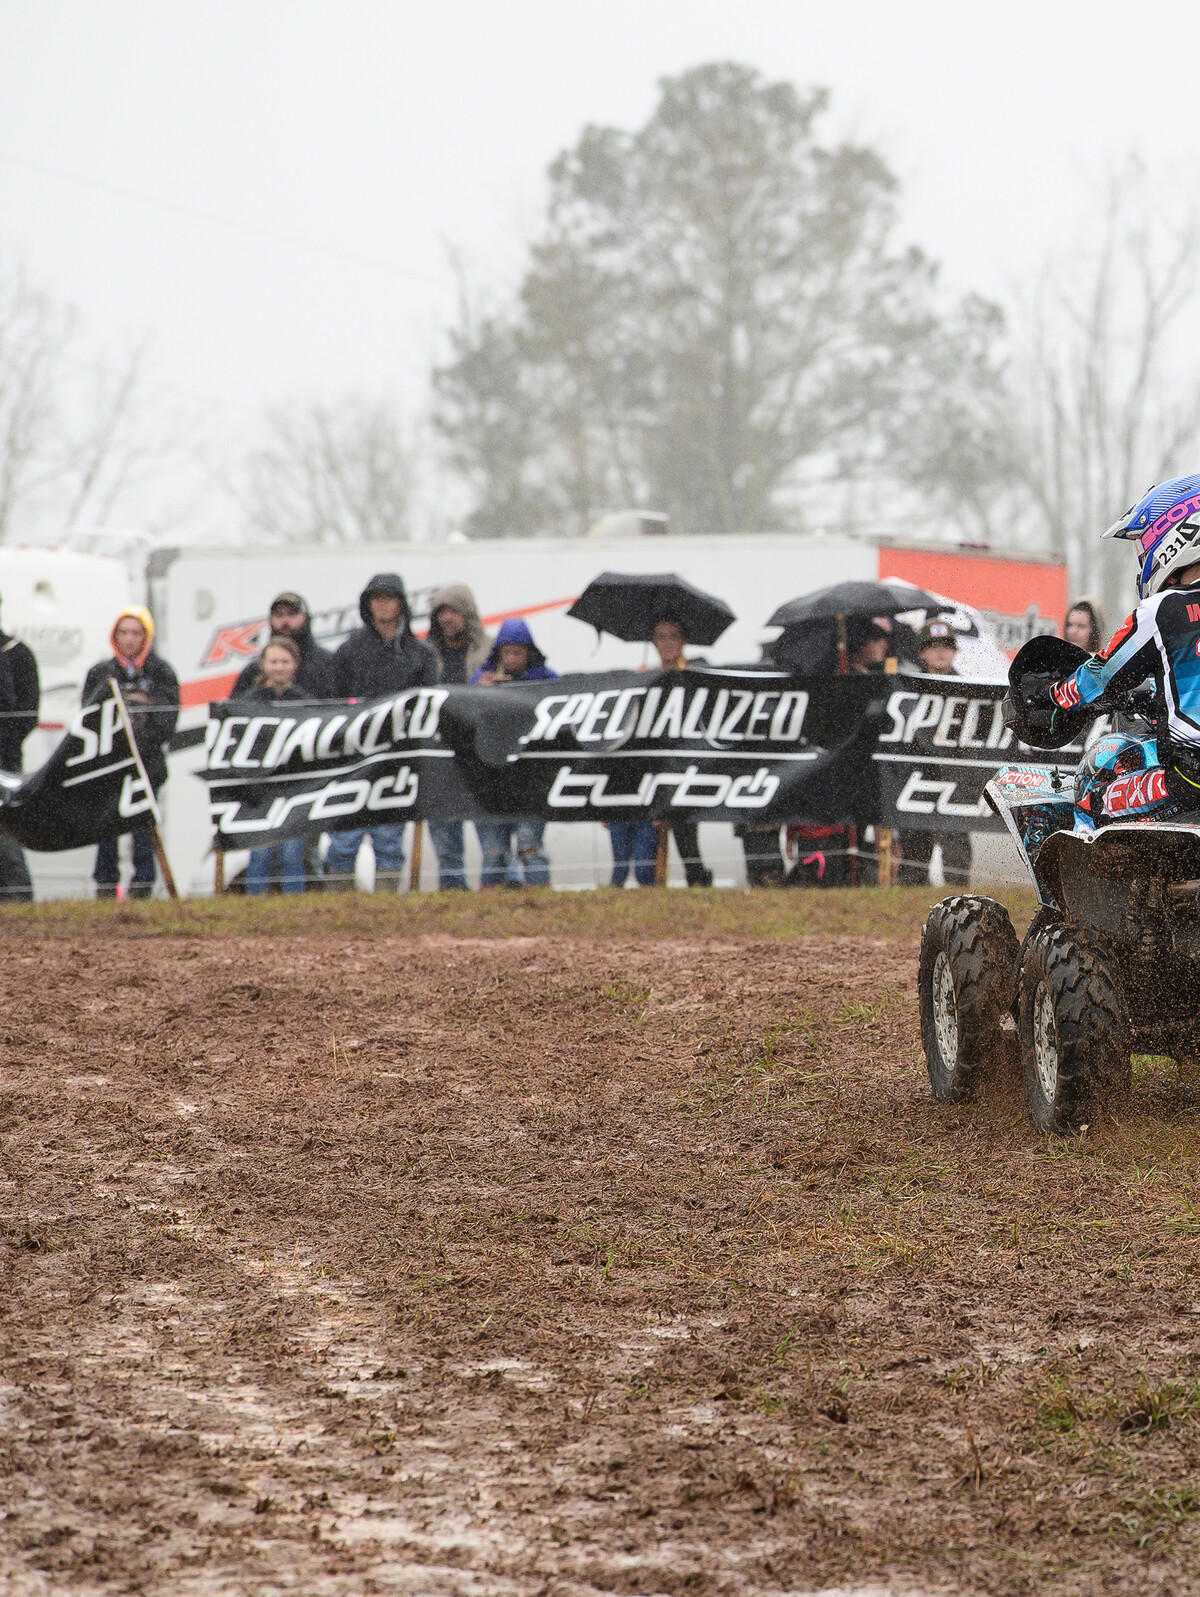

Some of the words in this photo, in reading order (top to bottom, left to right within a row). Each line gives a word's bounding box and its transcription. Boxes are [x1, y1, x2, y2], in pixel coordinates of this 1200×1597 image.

[1159, 537, 1187, 565] 231
[205, 689, 450, 769] ECIALIZED
[518, 687, 809, 744] SPECIALIZED
[548, 766, 780, 808] turbo
